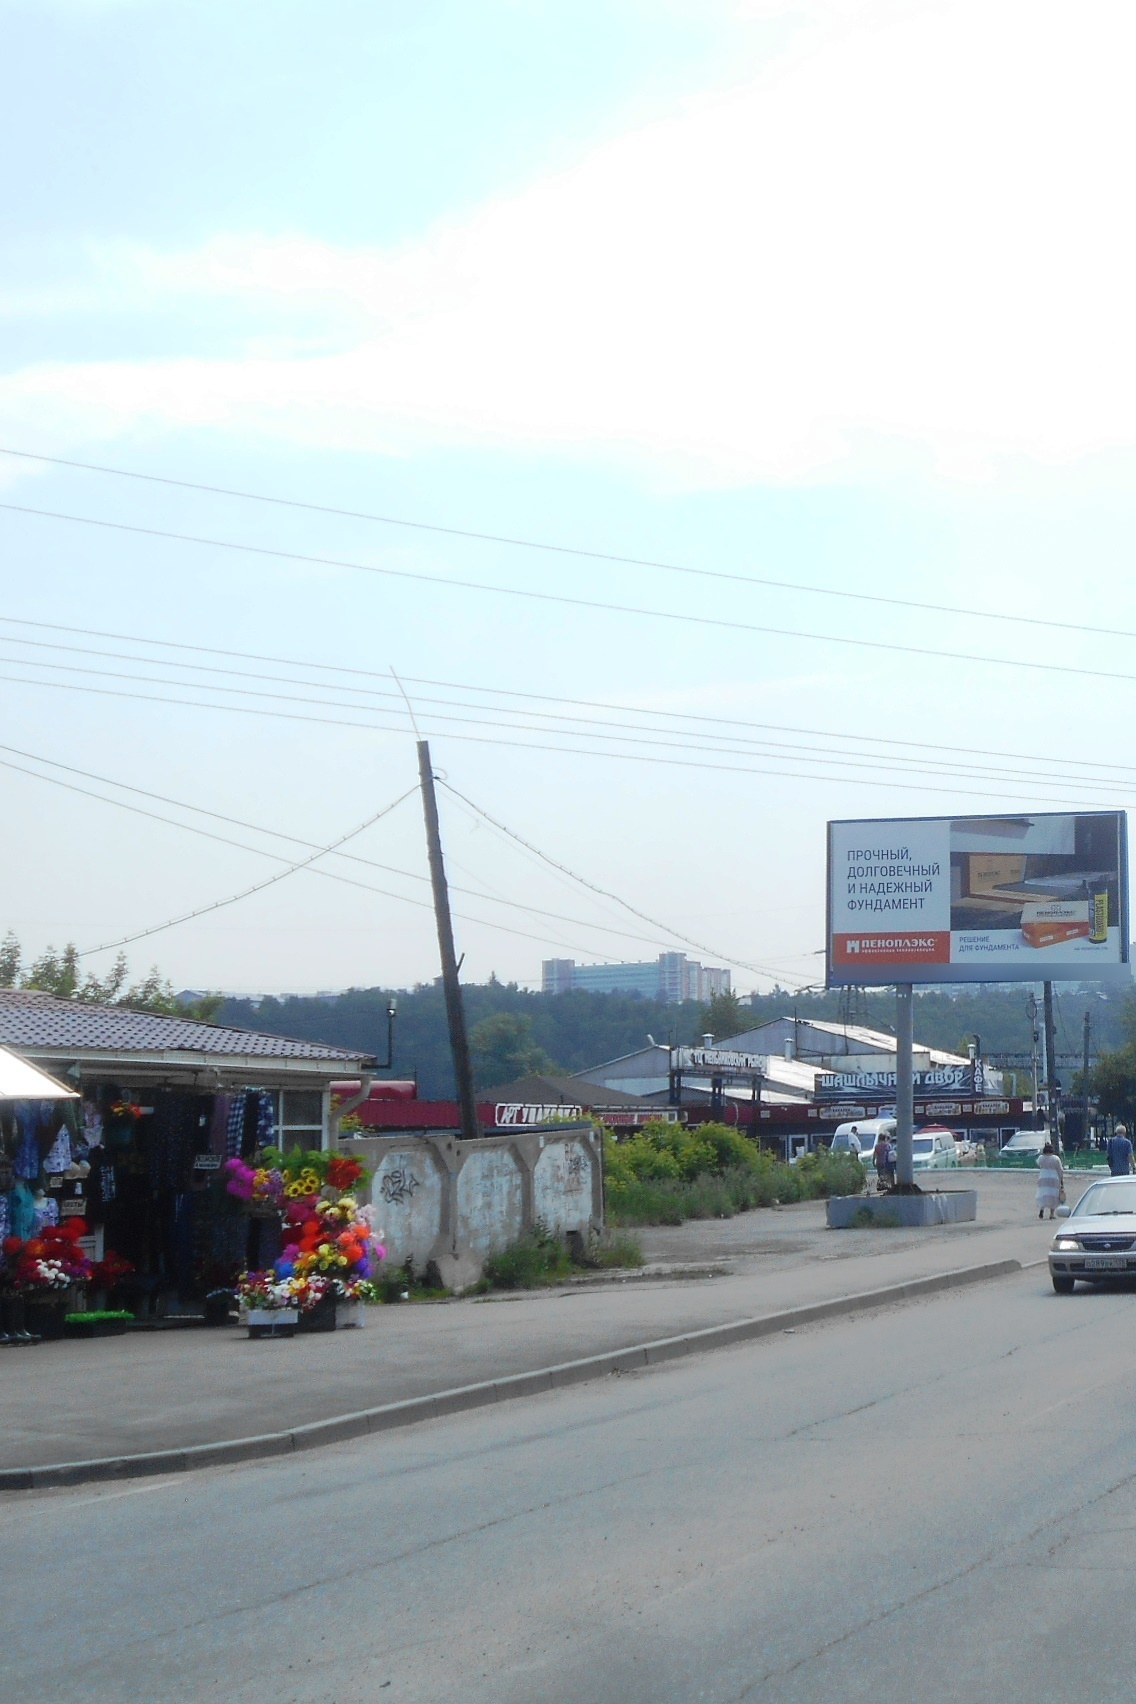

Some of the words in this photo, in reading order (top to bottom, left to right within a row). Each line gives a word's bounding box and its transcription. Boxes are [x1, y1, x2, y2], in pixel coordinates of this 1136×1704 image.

[847, 846, 912, 861] ПРОЧНЫЙ,
[847, 862, 940, 880] ДОЛГОВЕЧНЫЙ
[847, 883, 856, 894] И
[859, 879, 933, 896] НАДЕЖНЫЙ
[847, 897, 926, 913] ФУНДАМЕНТ
[861, 938, 936, 948] ПЕНОПЛЭКС
[959, 935, 990, 943] РЕШЕНИЕ
[958, 945, 973, 953] ДЛЯ
[974, 944, 1020, 953] ФУНДАМЕНТА
[693, 1051, 704, 1066] ТЦ
[821, 1071, 921, 1087] ШАШЛЫЧНЙ
[924, 1066, 965, 1086] ДВОР
[974, 1059, 983, 1092] КАФЕ
[500, 1106, 521, 1124] АРТ
